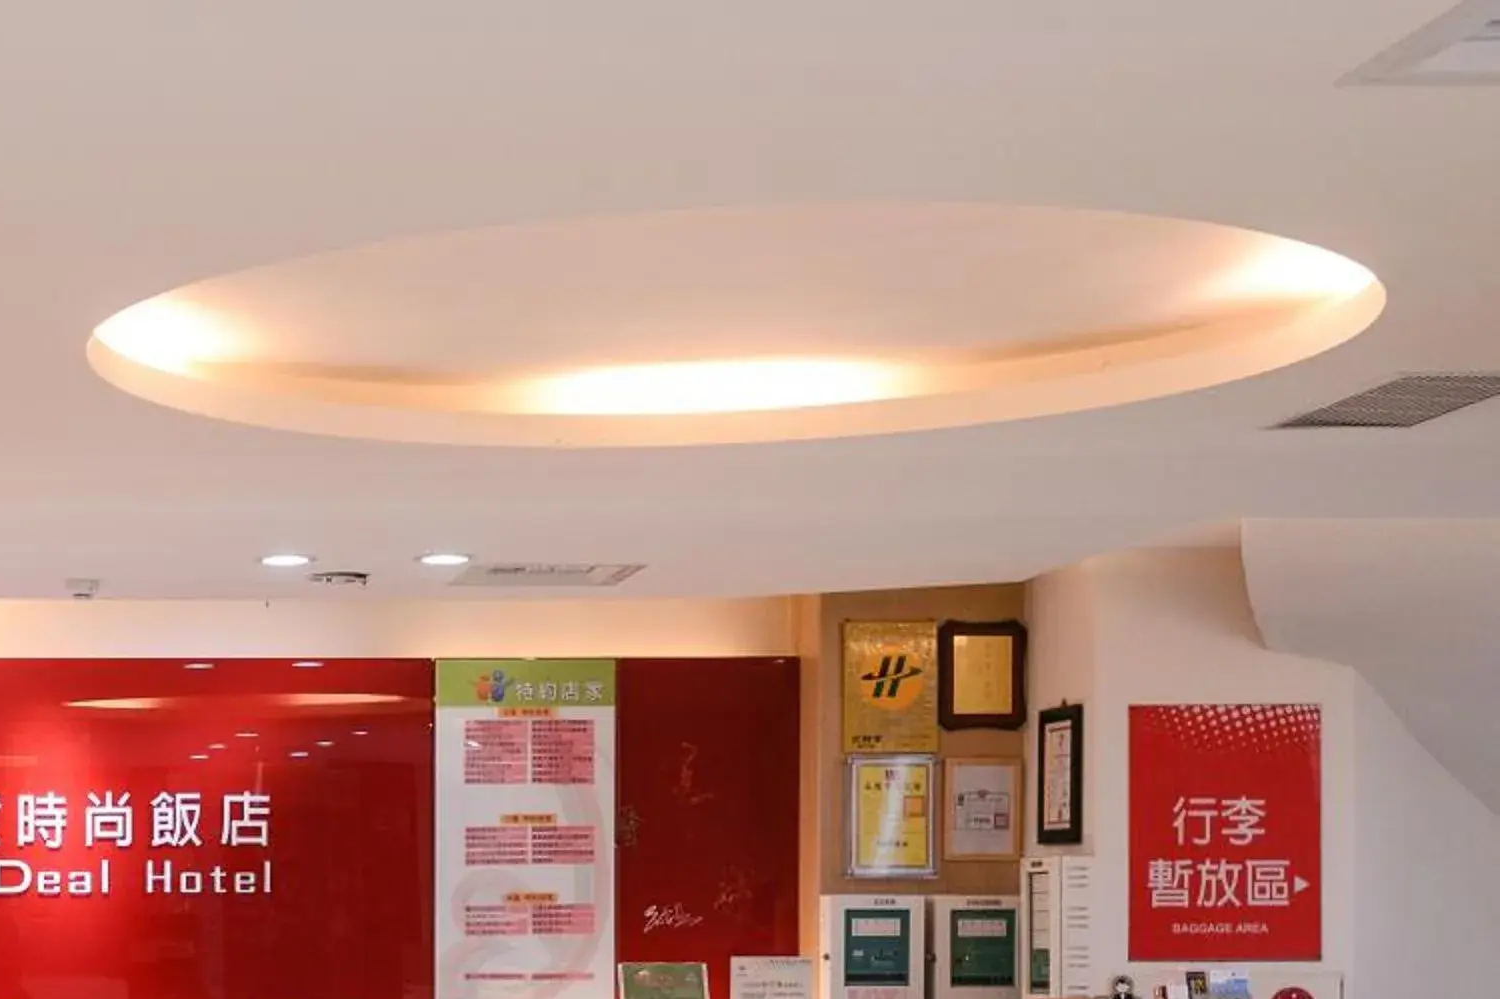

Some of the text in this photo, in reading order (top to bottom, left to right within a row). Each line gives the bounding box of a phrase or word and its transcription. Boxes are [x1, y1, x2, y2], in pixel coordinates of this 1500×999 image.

[1172, 795, 1266, 845] 行李
[145, 860, 271, 894] Hotel
[1148, 857, 1290, 908] 暫放區
[1172, 922, 1269, 934] BAGGAGE AREA
